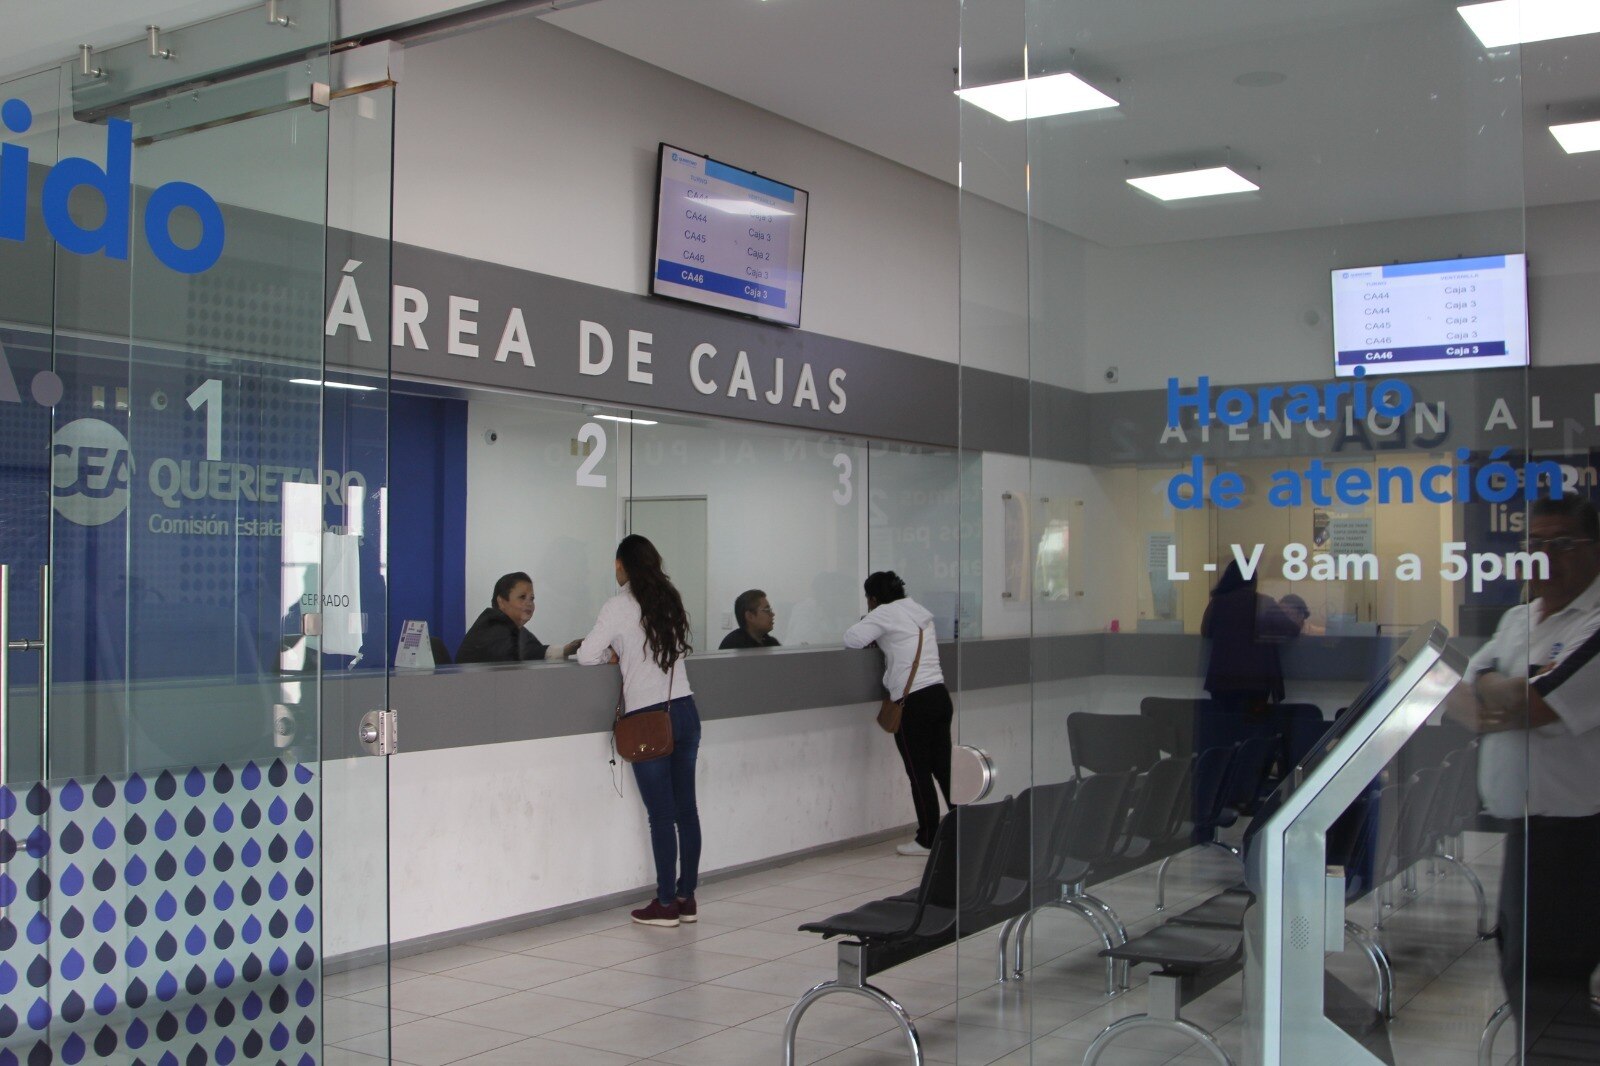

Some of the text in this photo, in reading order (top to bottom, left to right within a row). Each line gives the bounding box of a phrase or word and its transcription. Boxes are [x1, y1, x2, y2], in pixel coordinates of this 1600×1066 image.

[685, 209, 708, 224] CA44
[684, 229, 706, 243] CA45
[748, 228, 772, 242] Caja 3
[683, 250, 705, 264] CA46
[747, 247, 770, 261] Caja 2
[681, 270, 704, 284] CA46
[745, 266, 769, 280] Caja 3
[744, 285, 768, 299] Caja 3
[1363, 291, 1389, 301] CA44
[1444, 285, 1476, 295] Caja 3
[1364, 307, 1390, 316] CA44
[1445, 300, 1476, 310] Caja 3
[1365, 322, 1391, 330] CA45
[1446, 315, 1477, 325] Caja 2
[325, 259, 848, 416] ÁREA DE CAJAS
[1365, 337, 1392, 345] CA46
[1446, 331, 1469, 340] Caja
[1365, 351, 1393, 360] CA46
[1445, 345, 1479, 356] Caja 3
[1167, 365, 1414, 428] Horario
[185, 379, 222, 461] 1
[1483, 394, 1554, 432] AL
[575, 422, 608, 488] 2
[832, 453, 853, 506] 3
[1167, 455, 1246, 510] de
[1267, 446, 1564, 509] atención
[149, 513, 229, 535] Comisión
[235, 518, 283, 537] Estata
[1167, 544, 1189, 580] L
[1231, 543, 1265, 581] V
[1282, 541, 1379, 582] 8am
[1396, 552, 1422, 582] a
[1440, 541, 1550, 593] 5pm
[301, 593, 350, 608] CERRADO
